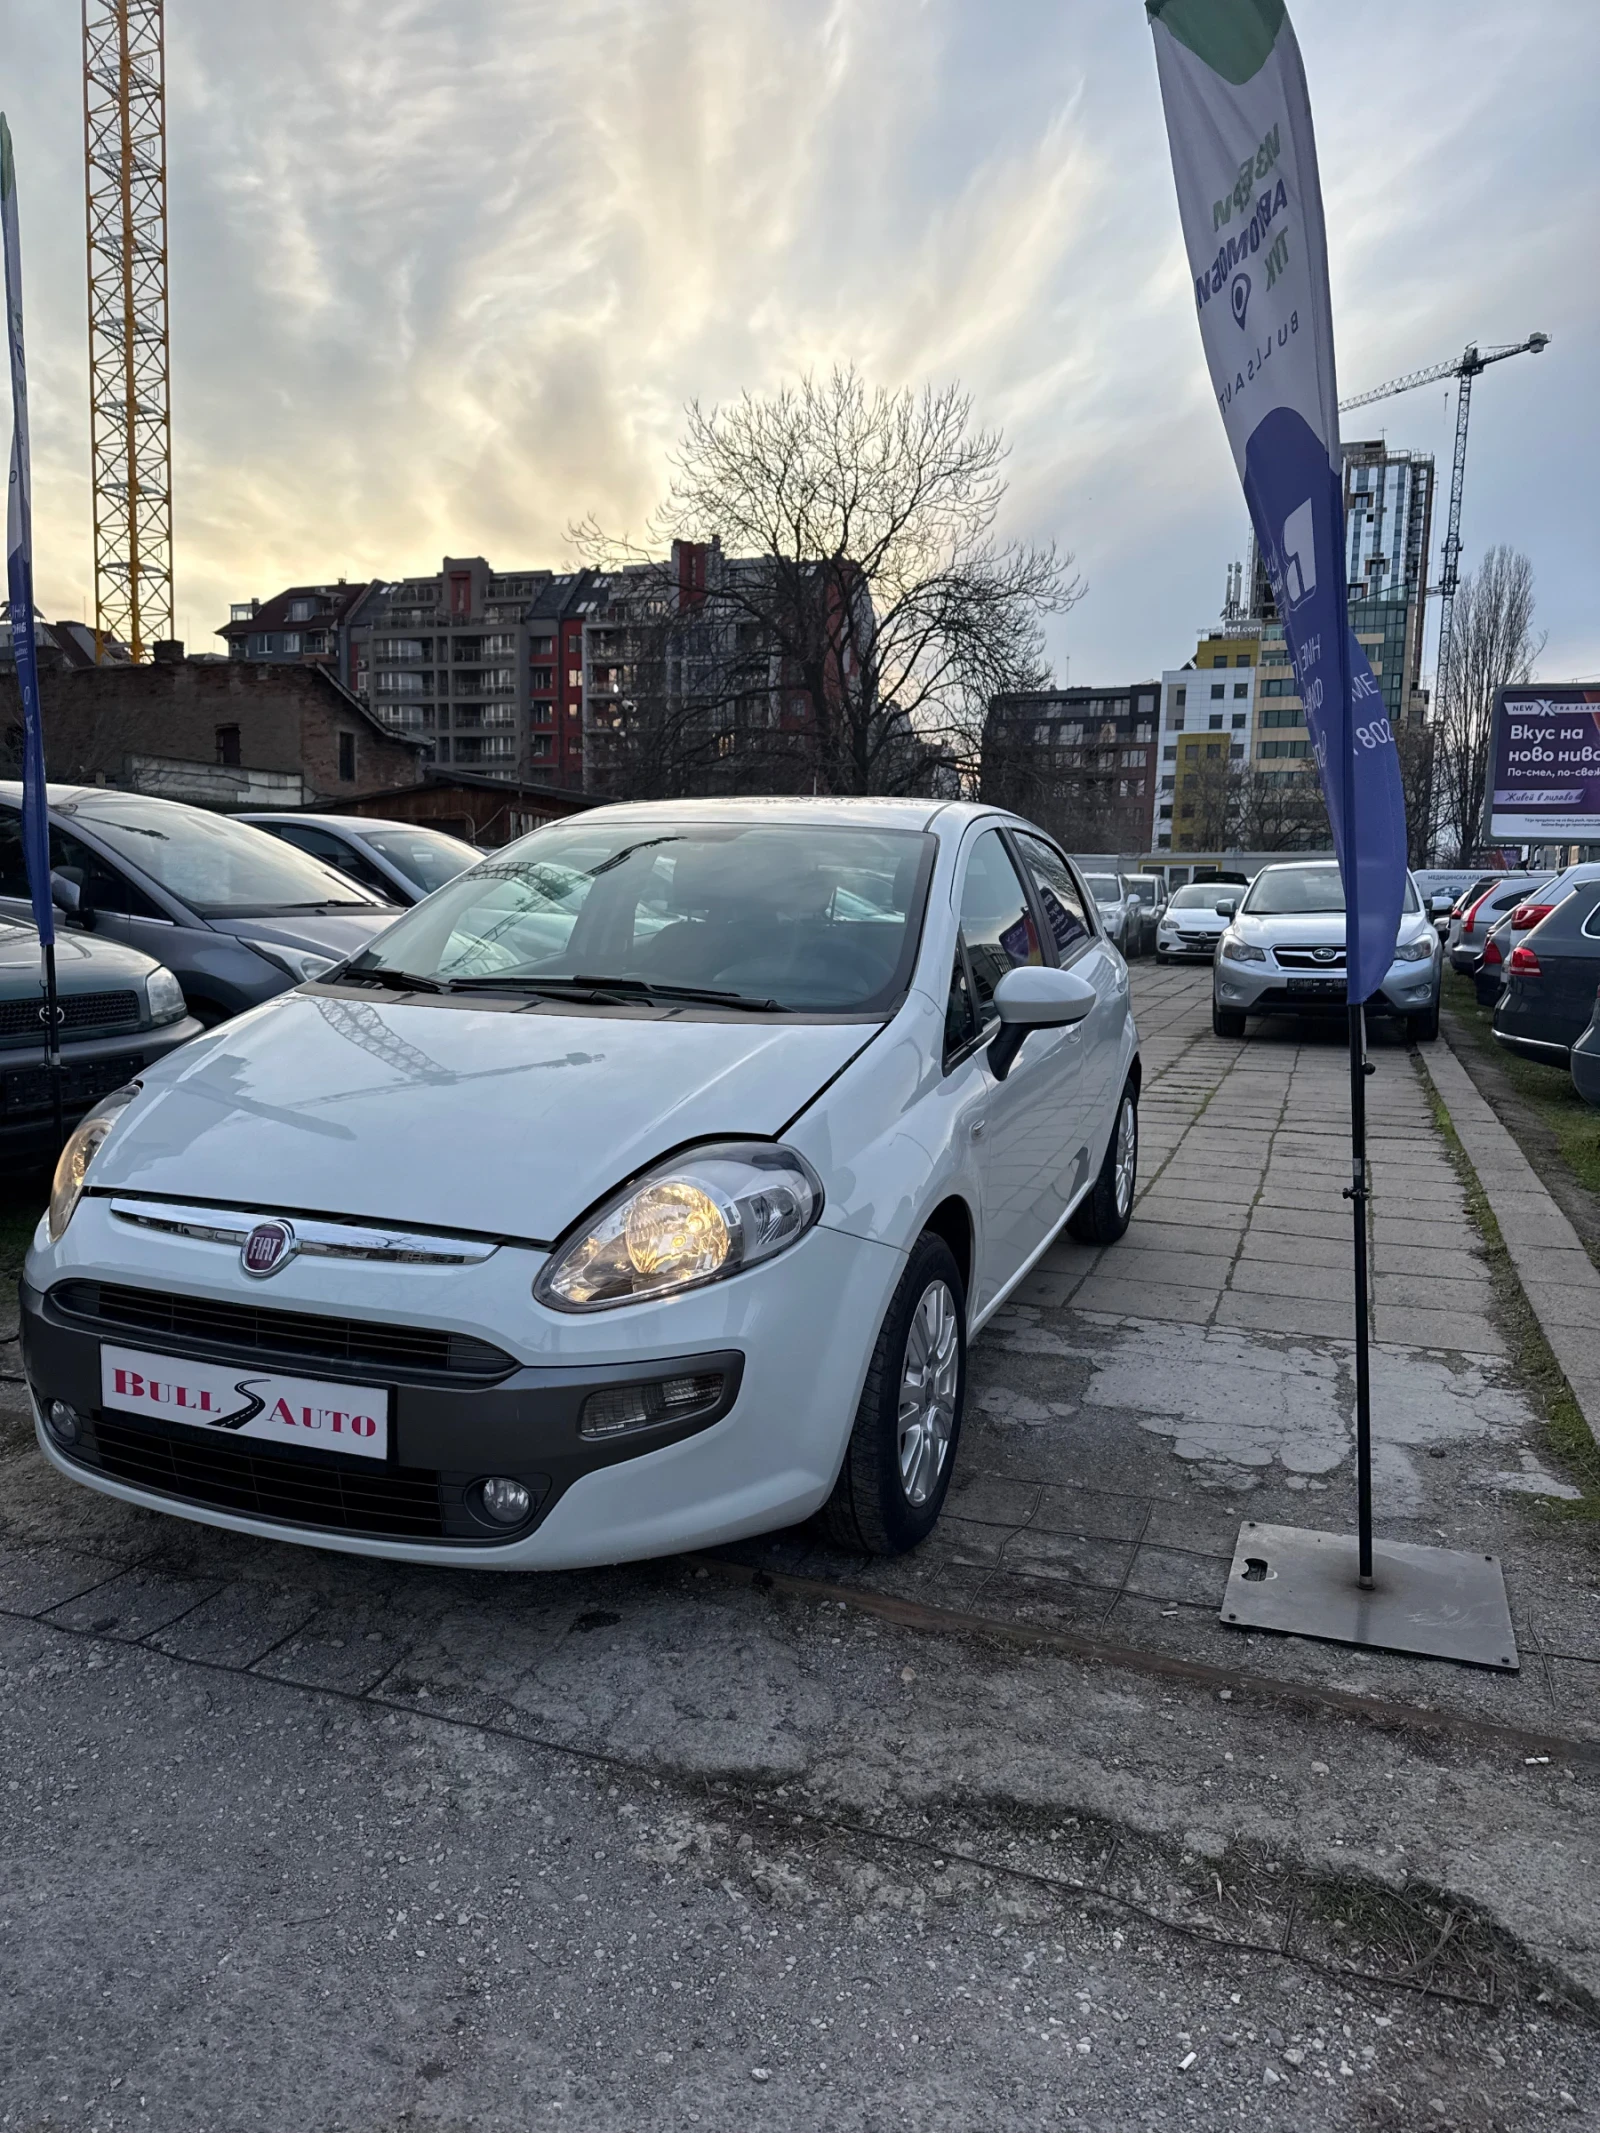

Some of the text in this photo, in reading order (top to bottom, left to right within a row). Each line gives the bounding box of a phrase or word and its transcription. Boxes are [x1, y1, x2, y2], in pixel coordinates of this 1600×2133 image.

[1512, 704, 1534, 712] NEW
[1510, 724, 1584, 744] Вкус на
[1508, 746, 1554, 762] ново
[1507, 767, 1555, 778] По-смел,
[1504, 791, 1574, 802] Живей в лилаво
[249, 1236, 281, 1261] FIAT
